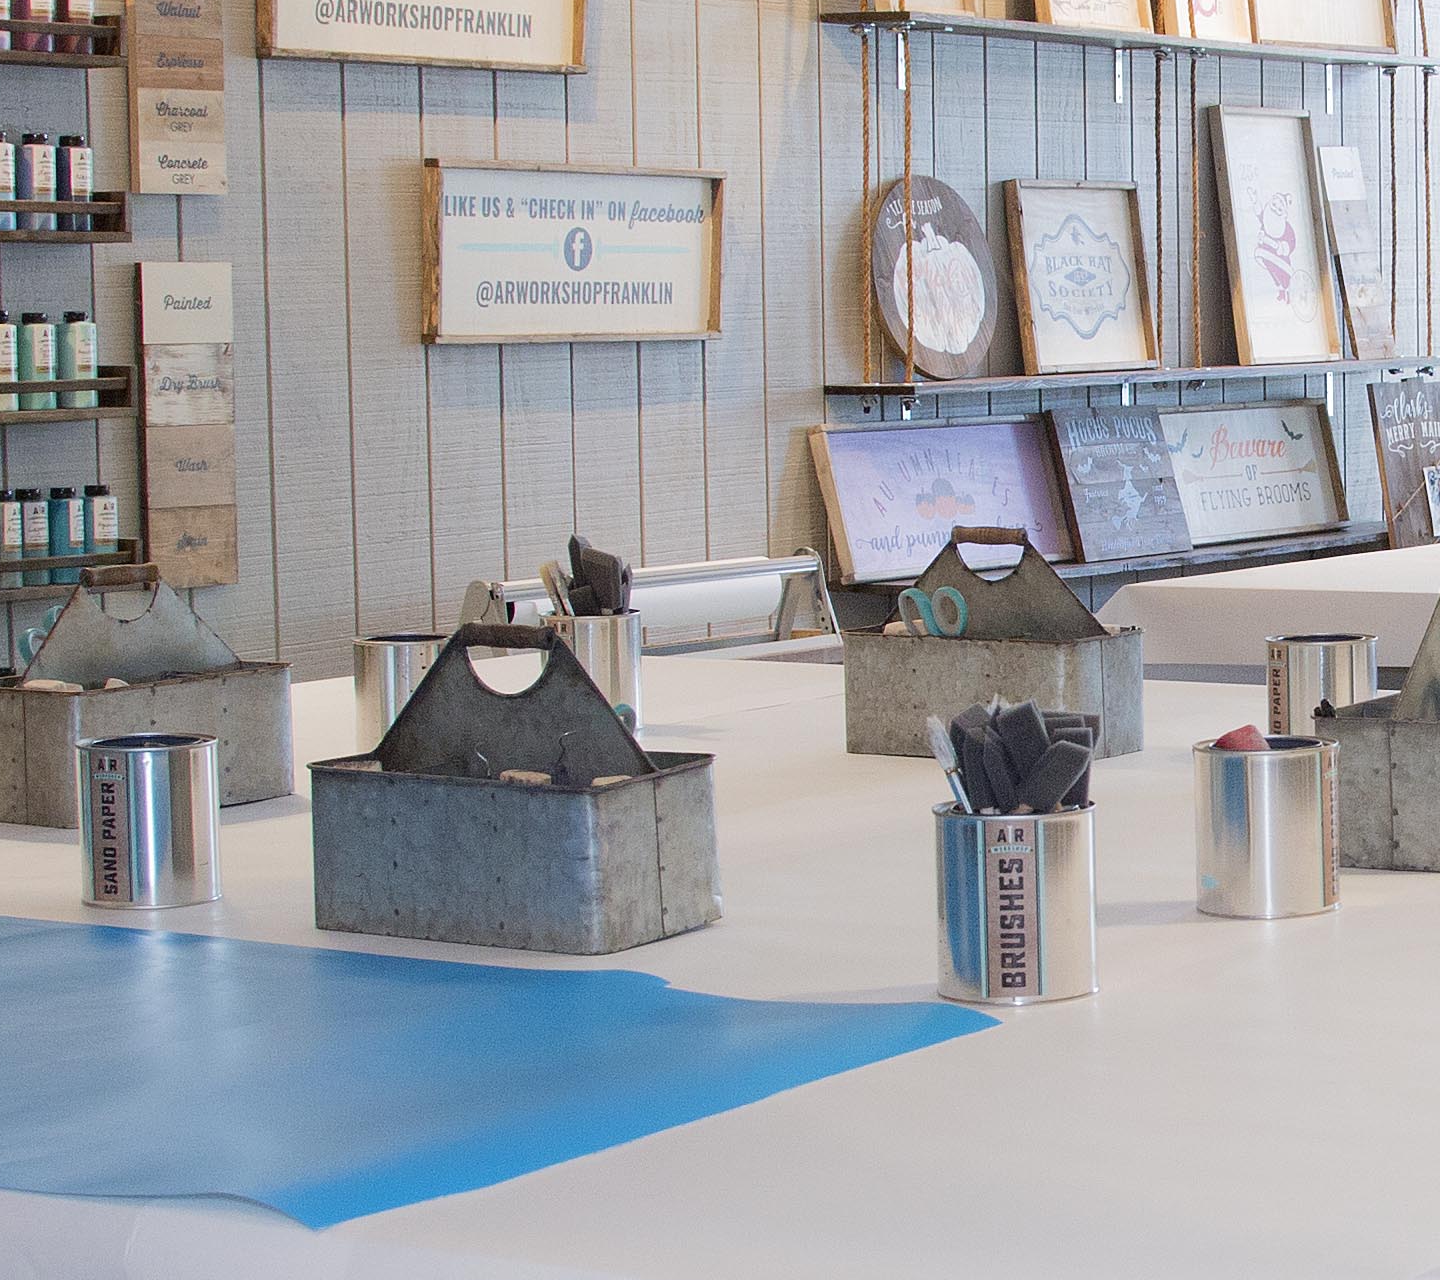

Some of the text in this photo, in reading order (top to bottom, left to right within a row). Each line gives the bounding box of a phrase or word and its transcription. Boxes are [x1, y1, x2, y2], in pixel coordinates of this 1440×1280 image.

[156, 0, 203, 19] Walnut
[156, 51, 204, 69] Espresso
[155, 100, 209, 118] Charcoal
[169, 121, 193, 133] GREY
[158, 154, 209, 171] Concrete
[171, 173, 196, 186] GREY
[444, 194, 477, 218] LIKE
[481, 196, 501, 218] US
[506, 198, 515, 218] &
[608, 200, 627, 222] ON
[628, 200, 705, 230] facebook
[916, 196, 943, 216] SEASON
[1045, 255, 1112, 275] BLACK HAT
[476, 280, 673, 308] @ARWORKSHOPFRANKLIN
[1048, 279, 1113, 298] SOCIETY
[163, 293, 213, 311] Painted
[160, 373, 223, 393] Dry Brush
[1066, 415, 1157, 452] HOCUS POCUS
[1385, 425, 1416, 446] MERRY
[1210, 422, 1287, 470] Beware
[1245, 464, 1258, 479] OF
[1200, 482, 1312, 512] FLYING BROOMS
[856, 525, 902, 553] and
[1270, 668, 1282, 716] PAPER
[101, 781, 119, 895] SAND PAPER
[998, 858, 1027, 988] BRUSHES
